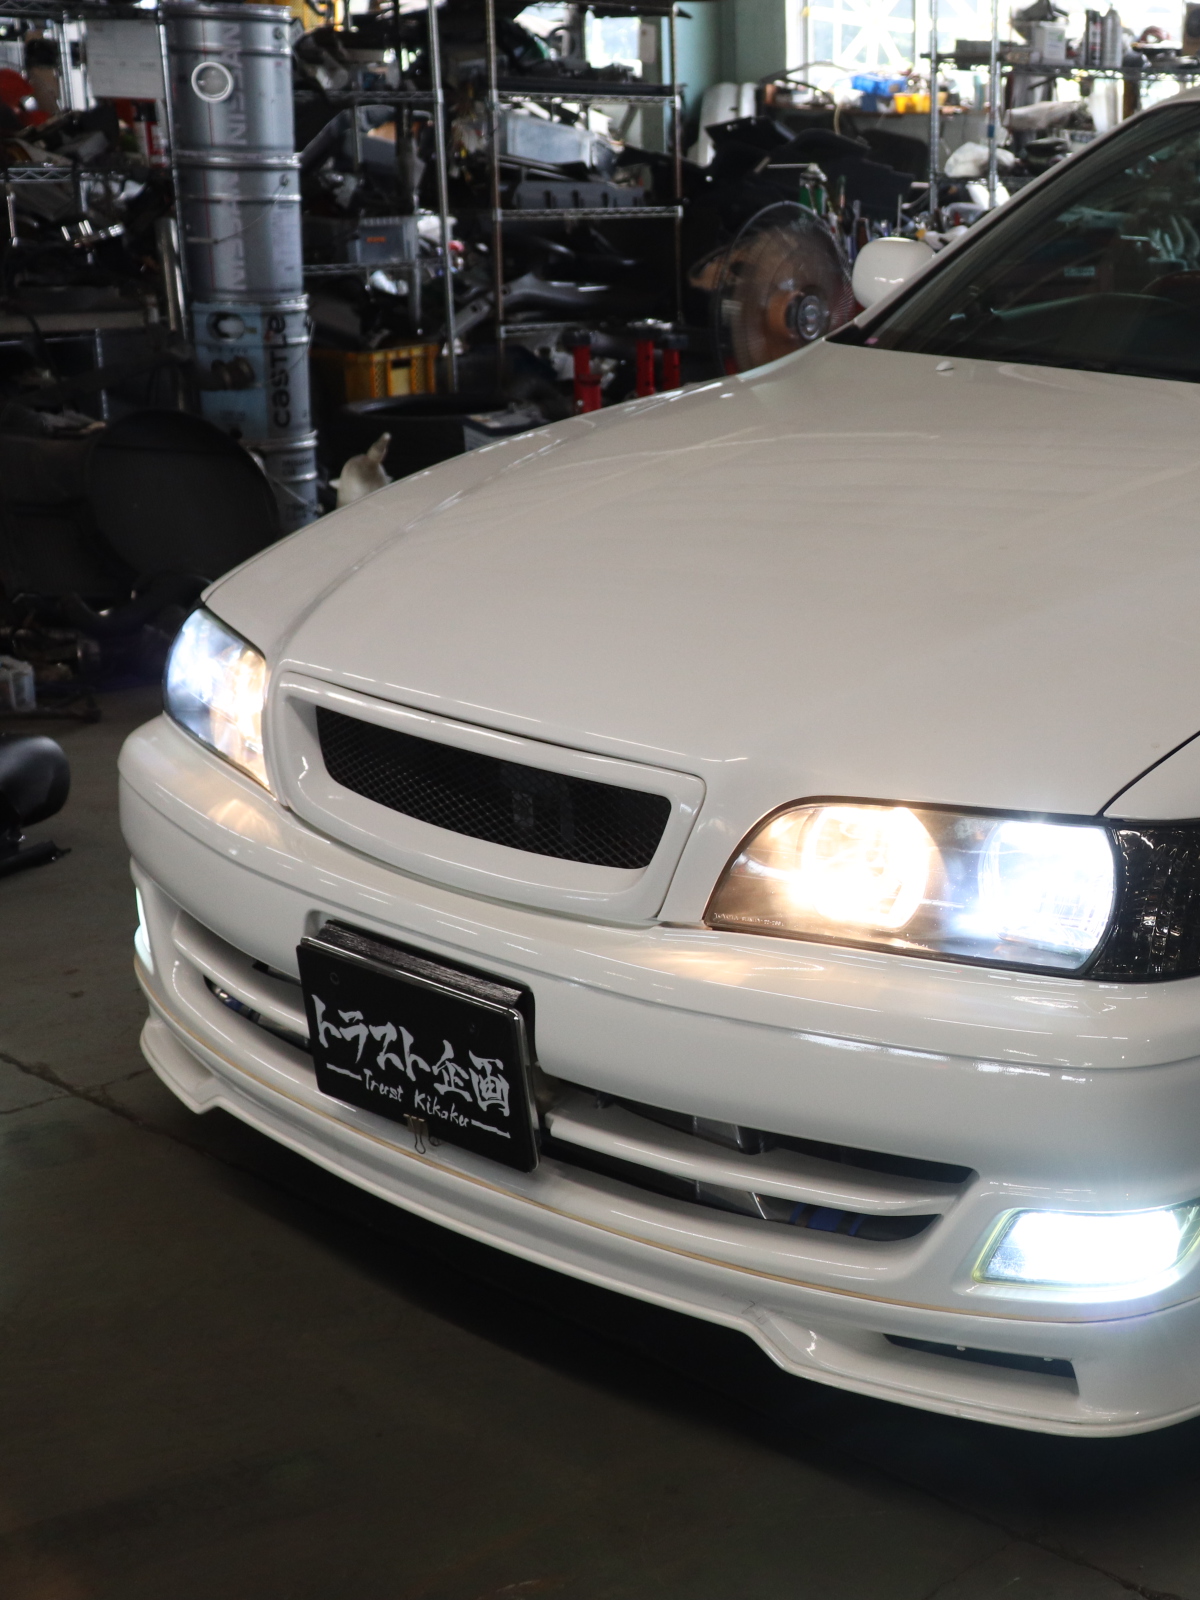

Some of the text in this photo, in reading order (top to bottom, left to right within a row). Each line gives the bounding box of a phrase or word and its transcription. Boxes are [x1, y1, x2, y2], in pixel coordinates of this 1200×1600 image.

[220, 23, 247, 145] NISSAN
[220, 172, 247, 290] NISSAN
[311, 994, 510, 1117] トラスト企画
[363, 1068, 469, 1127] Trust Kikaku
